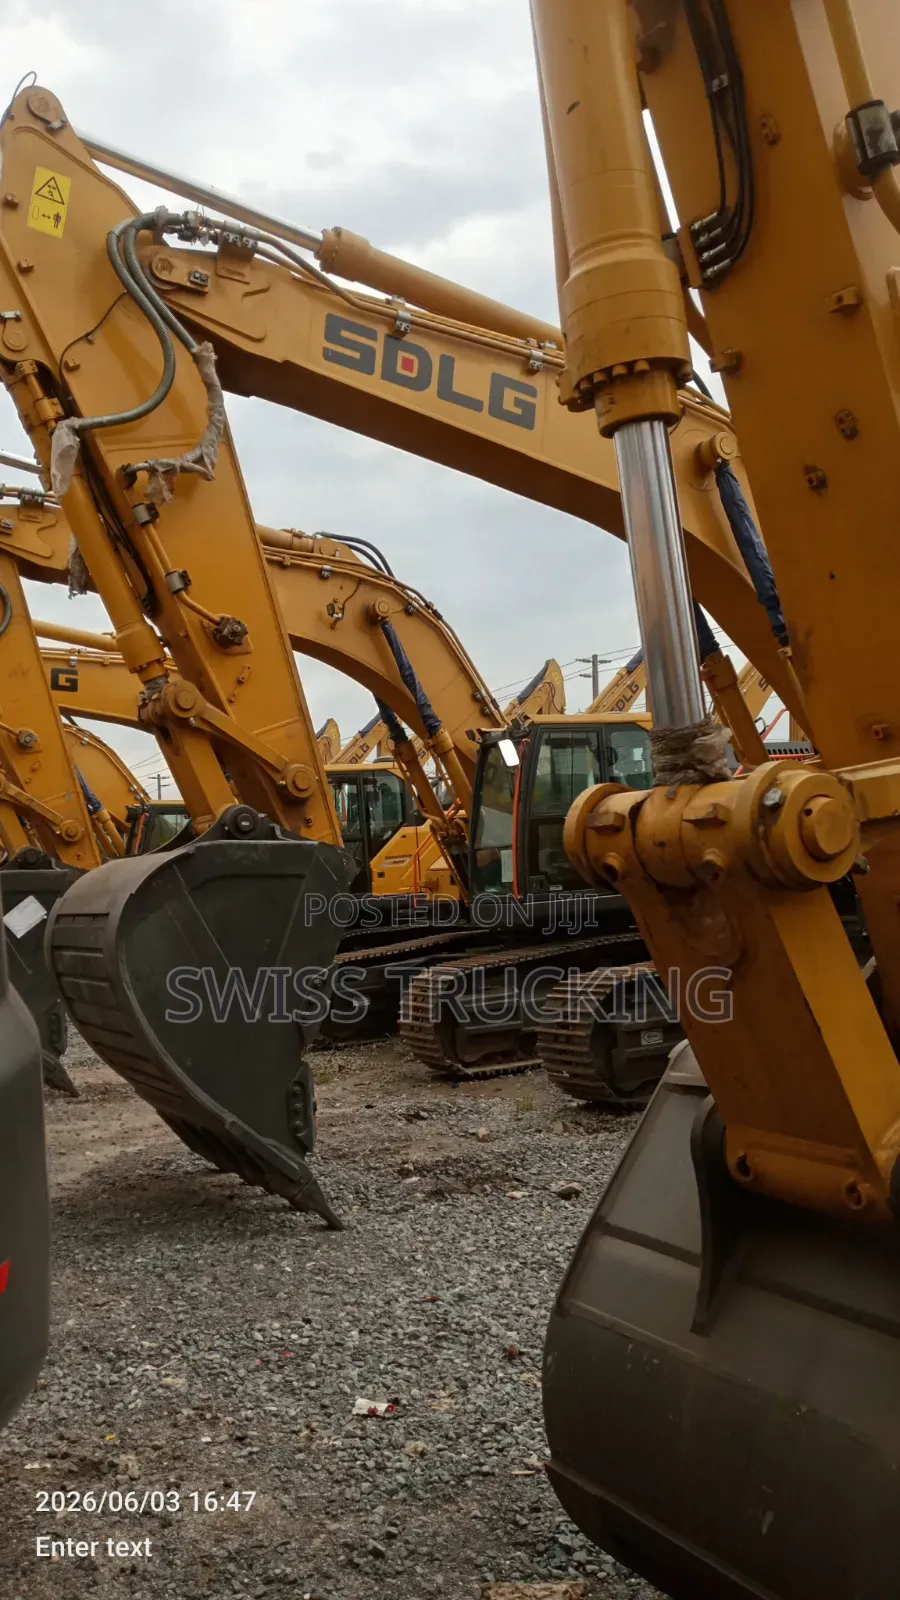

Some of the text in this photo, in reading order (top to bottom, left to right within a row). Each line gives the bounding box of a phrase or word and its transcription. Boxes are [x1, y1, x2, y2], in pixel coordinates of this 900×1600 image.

[322, 313, 538, 430] SDLG
[610, 681, 640, 711] DLG
[347, 743, 370, 764] DLG
